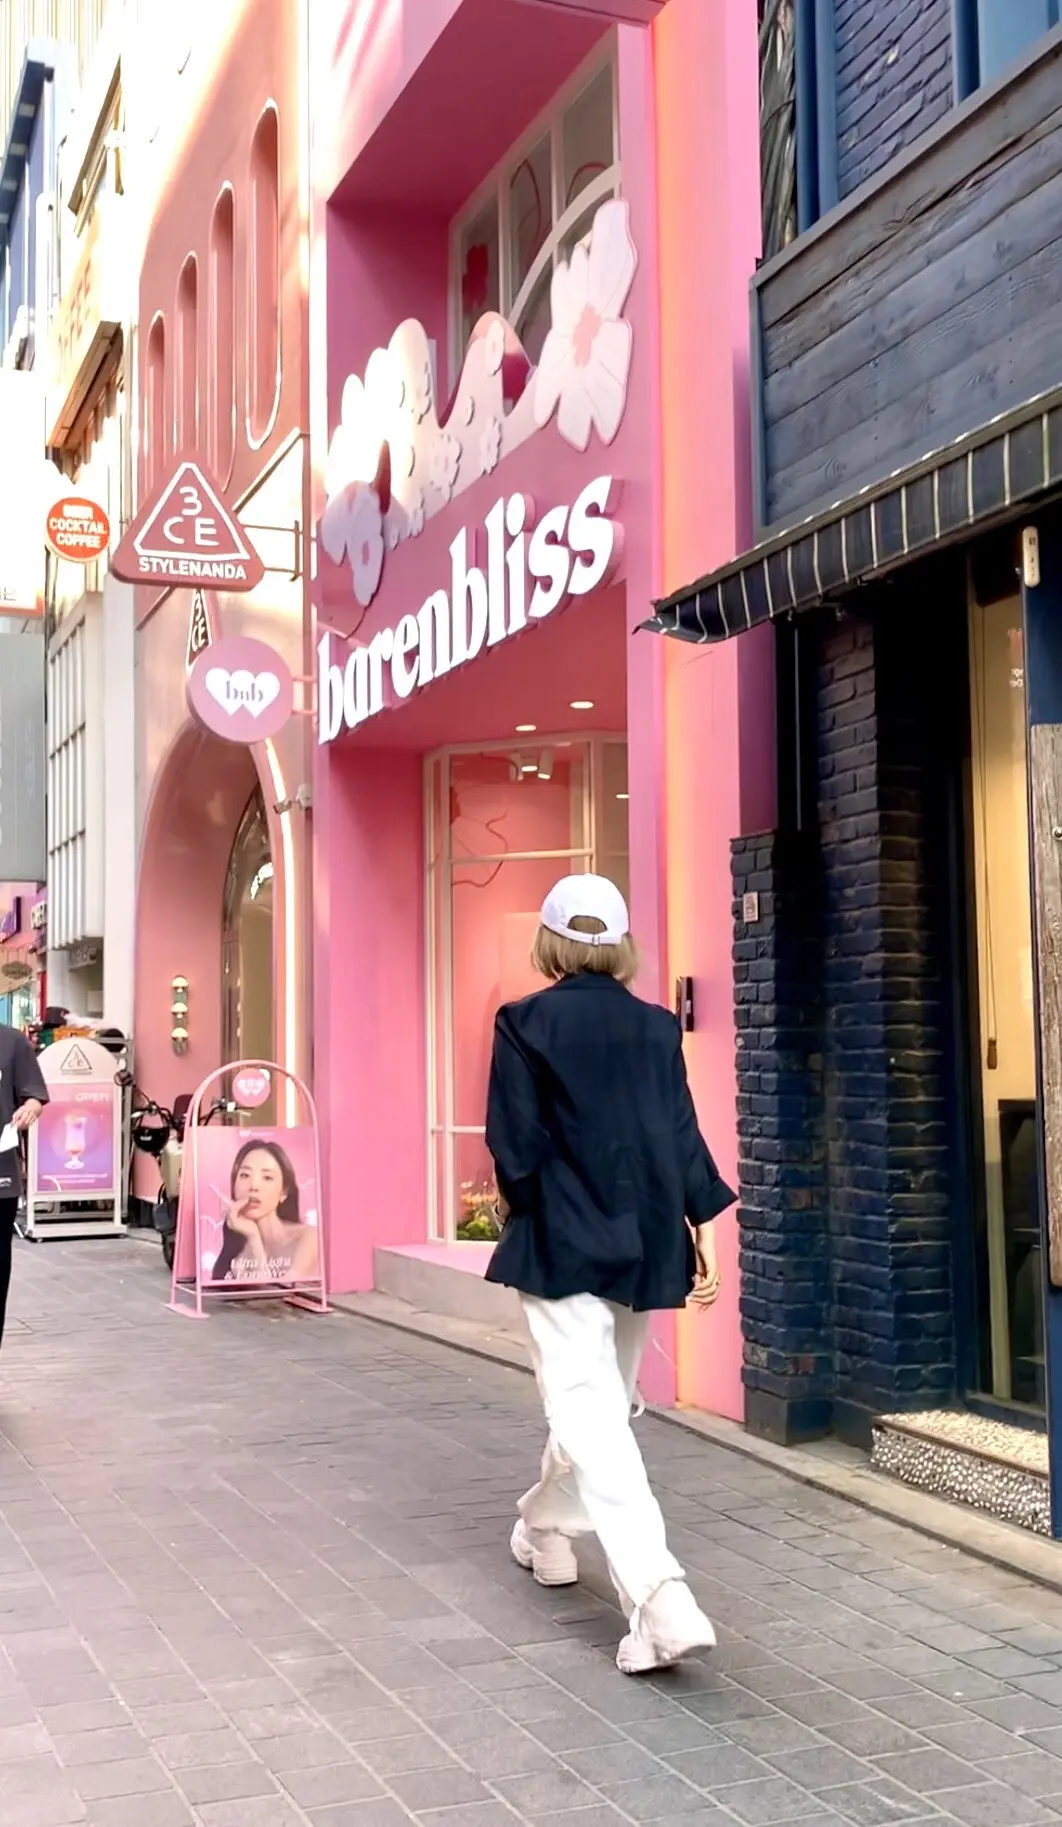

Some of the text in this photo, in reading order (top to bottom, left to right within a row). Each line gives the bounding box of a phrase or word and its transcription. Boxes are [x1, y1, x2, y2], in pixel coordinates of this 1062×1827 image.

[179, 486, 202, 515] 3
[49, 517, 107, 535] COCKTAIL
[163, 517, 220, 546] CE
[56, 533, 101, 549] COFFEE
[139, 556, 247, 580] STYLENANDA
[317, 475, 614, 745] barenbliss
